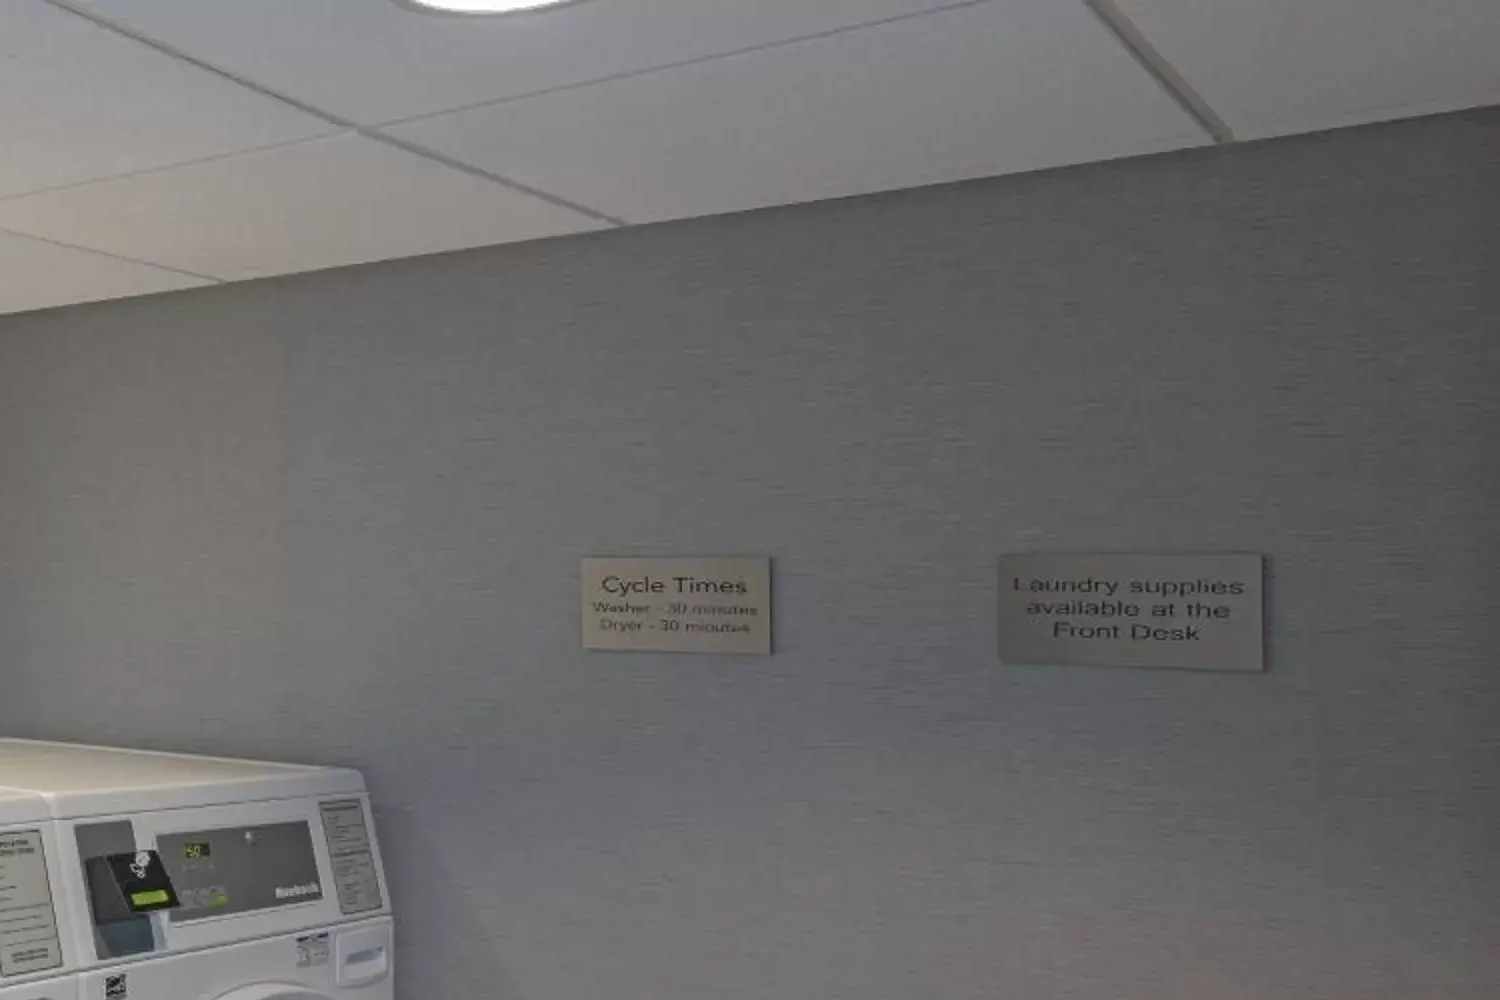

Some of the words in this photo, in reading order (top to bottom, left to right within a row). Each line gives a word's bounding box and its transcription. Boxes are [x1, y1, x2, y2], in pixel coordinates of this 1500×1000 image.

[601, 575, 665, 597] Cycle
[672, 576, 747, 594] Times
[1013, 577, 1119, 597] Laundry
[1129, 578, 1245, 598] supplies
[593, 602, 649, 614] Washer
[666, 602, 686, 615] 30
[692, 604, 757, 616] minutes
[1025, 600, 1140, 617] available
[1151, 603, 1176, 618] at
[1187, 603, 1231, 619] the
[600, 619, 642, 632] Dryer
[660, 619, 679, 632] 30
[685, 622, 749, 633] minutes
[1053, 621, 1120, 639] Front
[1130, 624, 1200, 641] Desk
